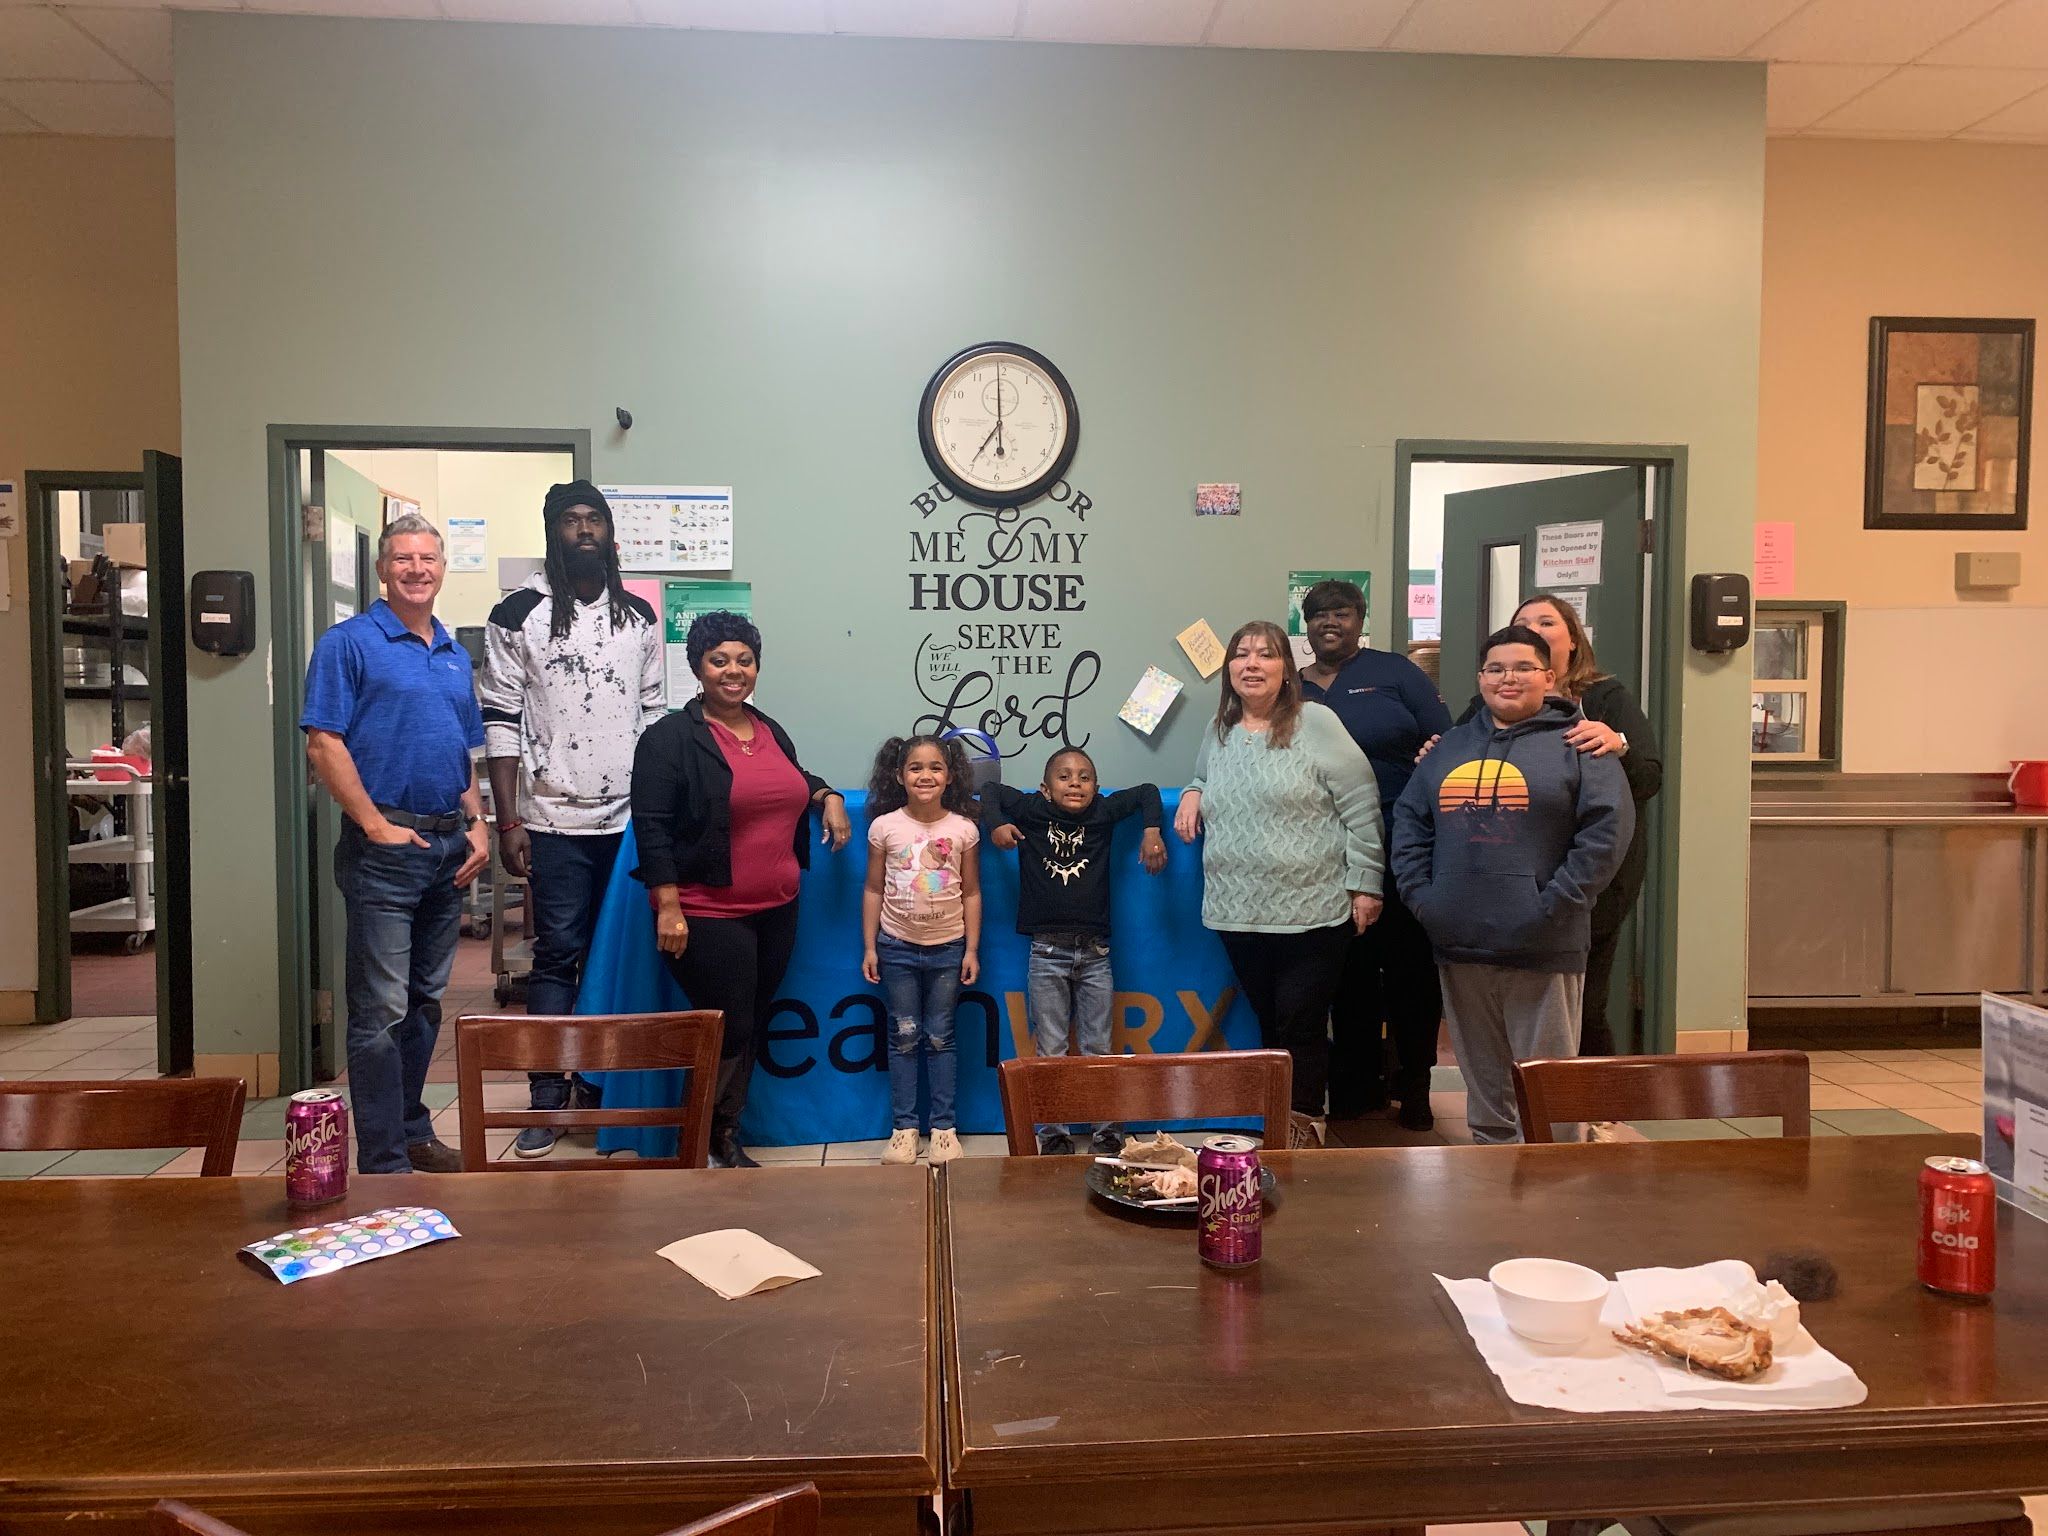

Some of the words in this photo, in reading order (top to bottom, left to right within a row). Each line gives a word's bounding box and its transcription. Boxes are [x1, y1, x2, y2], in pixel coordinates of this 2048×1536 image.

[972, 373, 982, 382] 11
[952, 390, 964, 399] 10
[1042, 395, 1048, 405] 2
[944, 417, 950, 425] 9
[1049, 423, 1055, 432] 3
[950, 443, 956, 451] 8
[1040, 449, 1046, 457] 4
[994, 472, 1000, 481] 6
[910, 482, 955, 519] BU
[1047, 479, 1093, 522] OR
[1564, 531, 1584, 539] Doors
[909, 531, 966, 563] ME
[1029, 533, 1088, 564] MY
[1561, 544, 1587, 553] Opened
[1589, 543, 1598, 551] by
[1543, 559, 1573, 567] Kitchen
[1575, 556, 1595, 564] Staff
[909, 573, 1086, 611] HOUSE
[958, 624, 1062, 649] SERVE
[930, 652, 951, 661] WE
[929, 662, 961, 672] WILL
[991, 655, 1053, 675] THE
[913, 634, 1101, 758] Lord
[286, 1112, 342, 1161] Shasta
[306, 1154, 339, 1165] Grape
[1201, 1166, 1261, 1218] Shasta
[1231, 1211, 1260, 1225] Grape
[1931, 1231, 1979, 1250] cola
